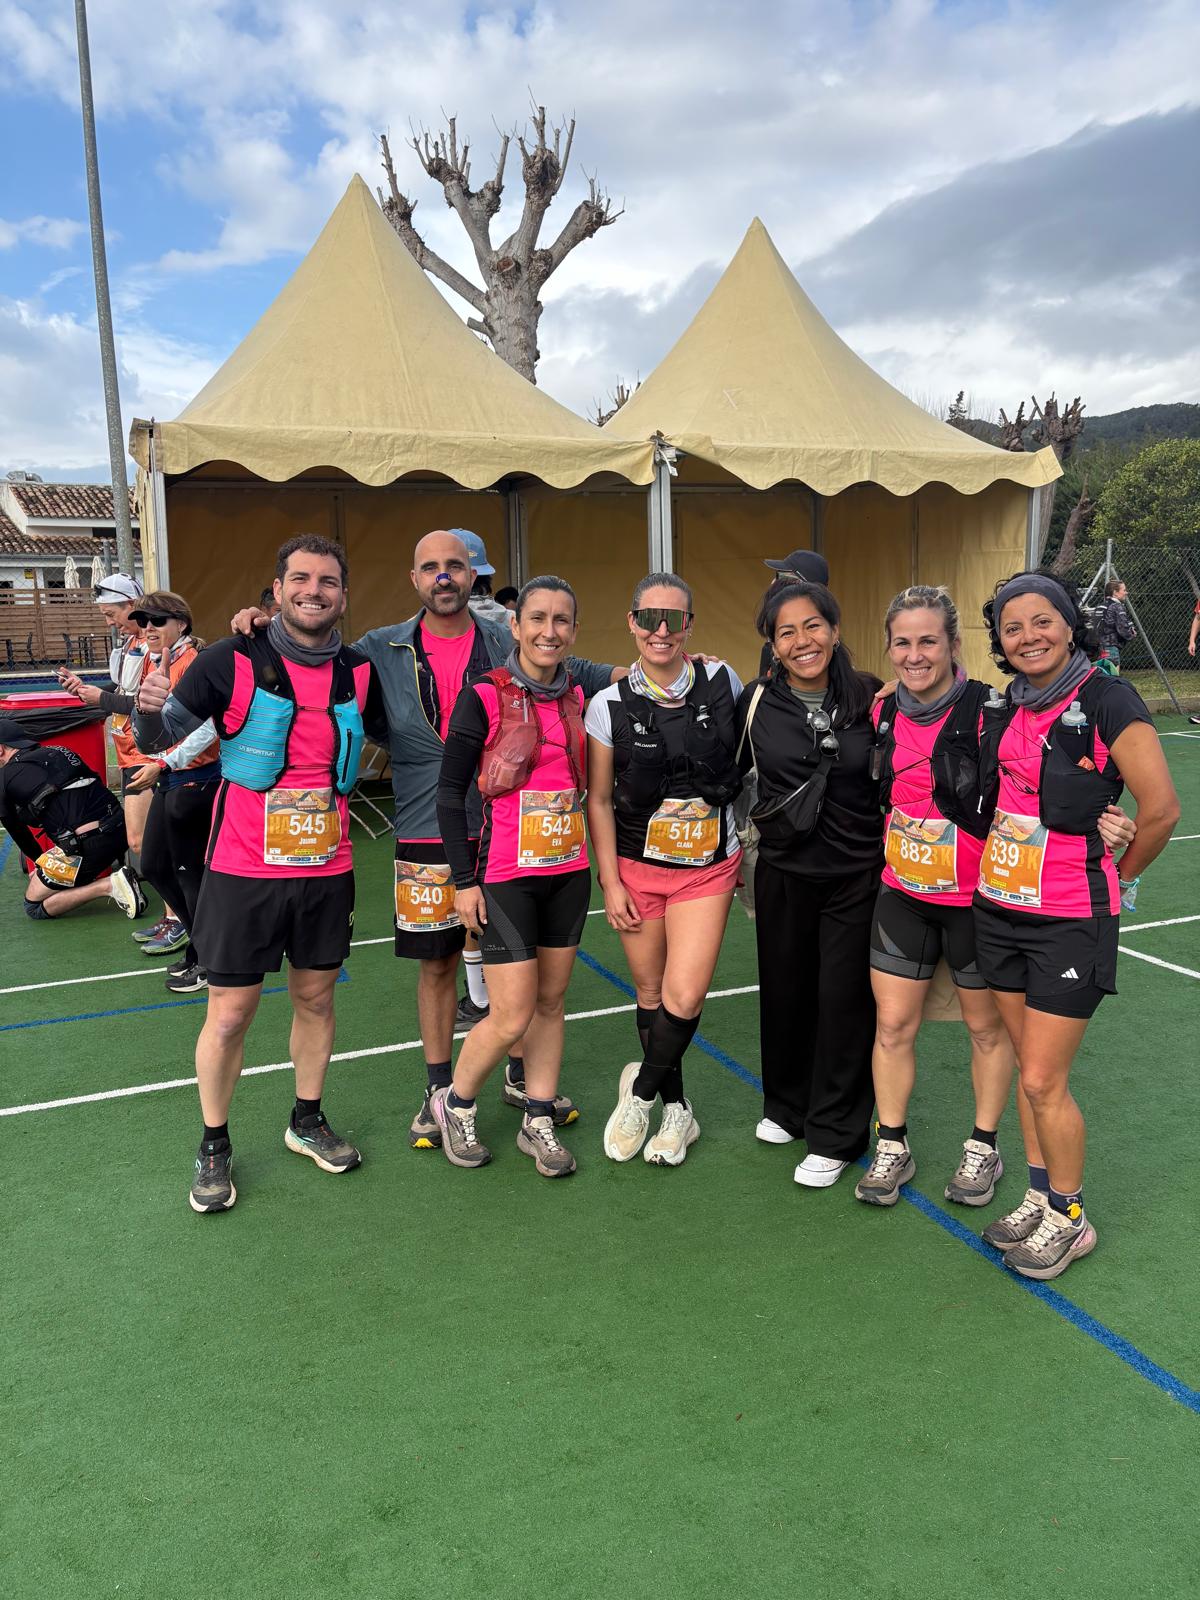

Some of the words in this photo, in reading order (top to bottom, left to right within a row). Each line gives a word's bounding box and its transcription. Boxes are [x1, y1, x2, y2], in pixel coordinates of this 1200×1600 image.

[289, 814, 326, 836] 545
[541, 814, 572, 837] 542
[669, 821, 703, 841] 514
[900, 838, 933, 865] 882
[990, 838, 1020, 868] 539
[45, 857, 66, 874] 873
[410, 886, 443, 905] 540
